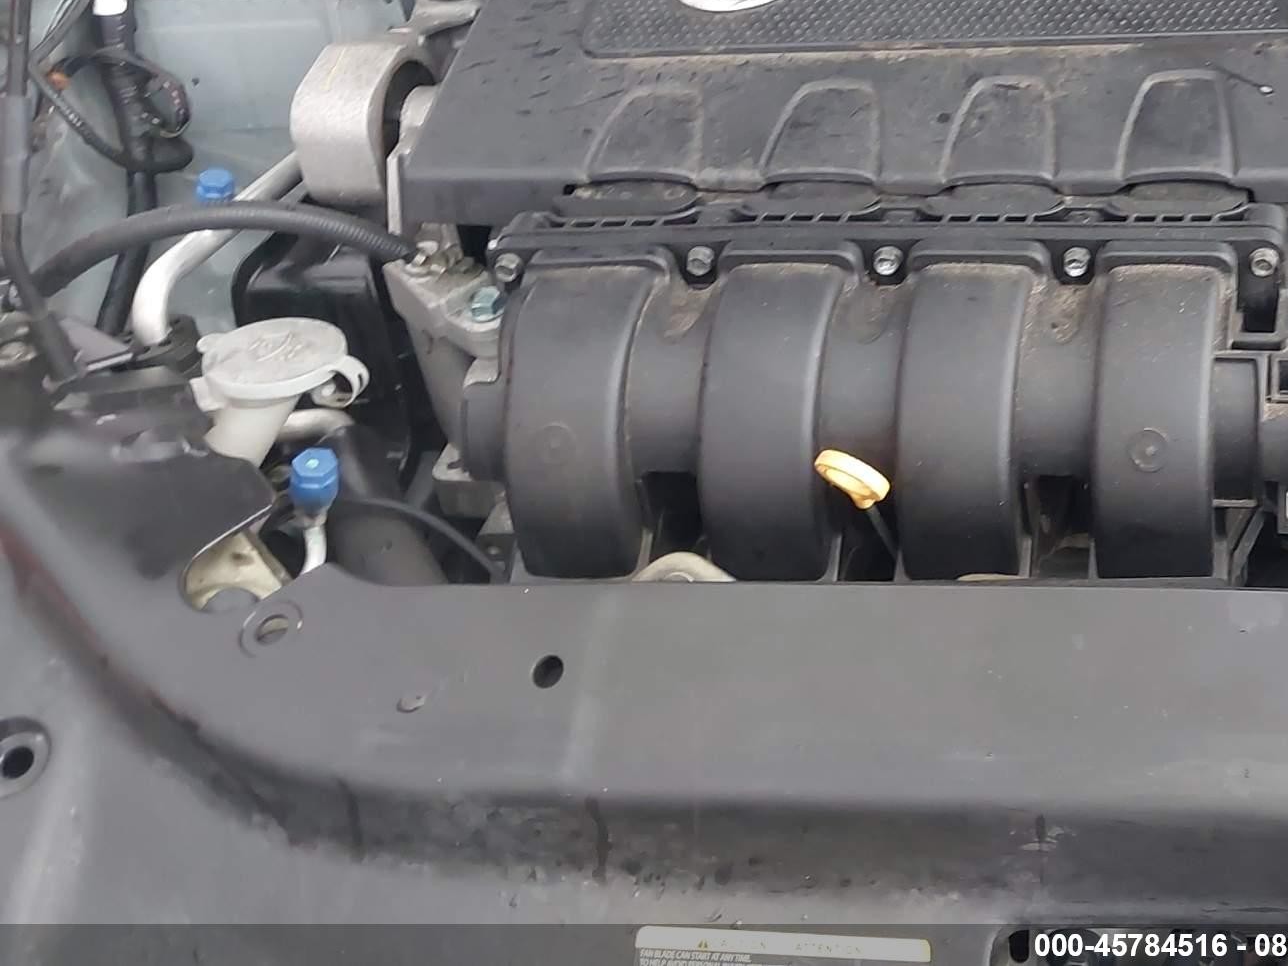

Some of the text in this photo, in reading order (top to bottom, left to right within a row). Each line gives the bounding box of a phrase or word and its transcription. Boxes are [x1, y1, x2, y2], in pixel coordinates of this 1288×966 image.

[640, 948, 654, 958] FAN
[654, 949, 675, 959] BLADE
[675, 950, 691, 960] CAN
[691, 951, 711, 961] START
[711, 952, 721, 962] AT
[720, 953, 735, 962] ANY
